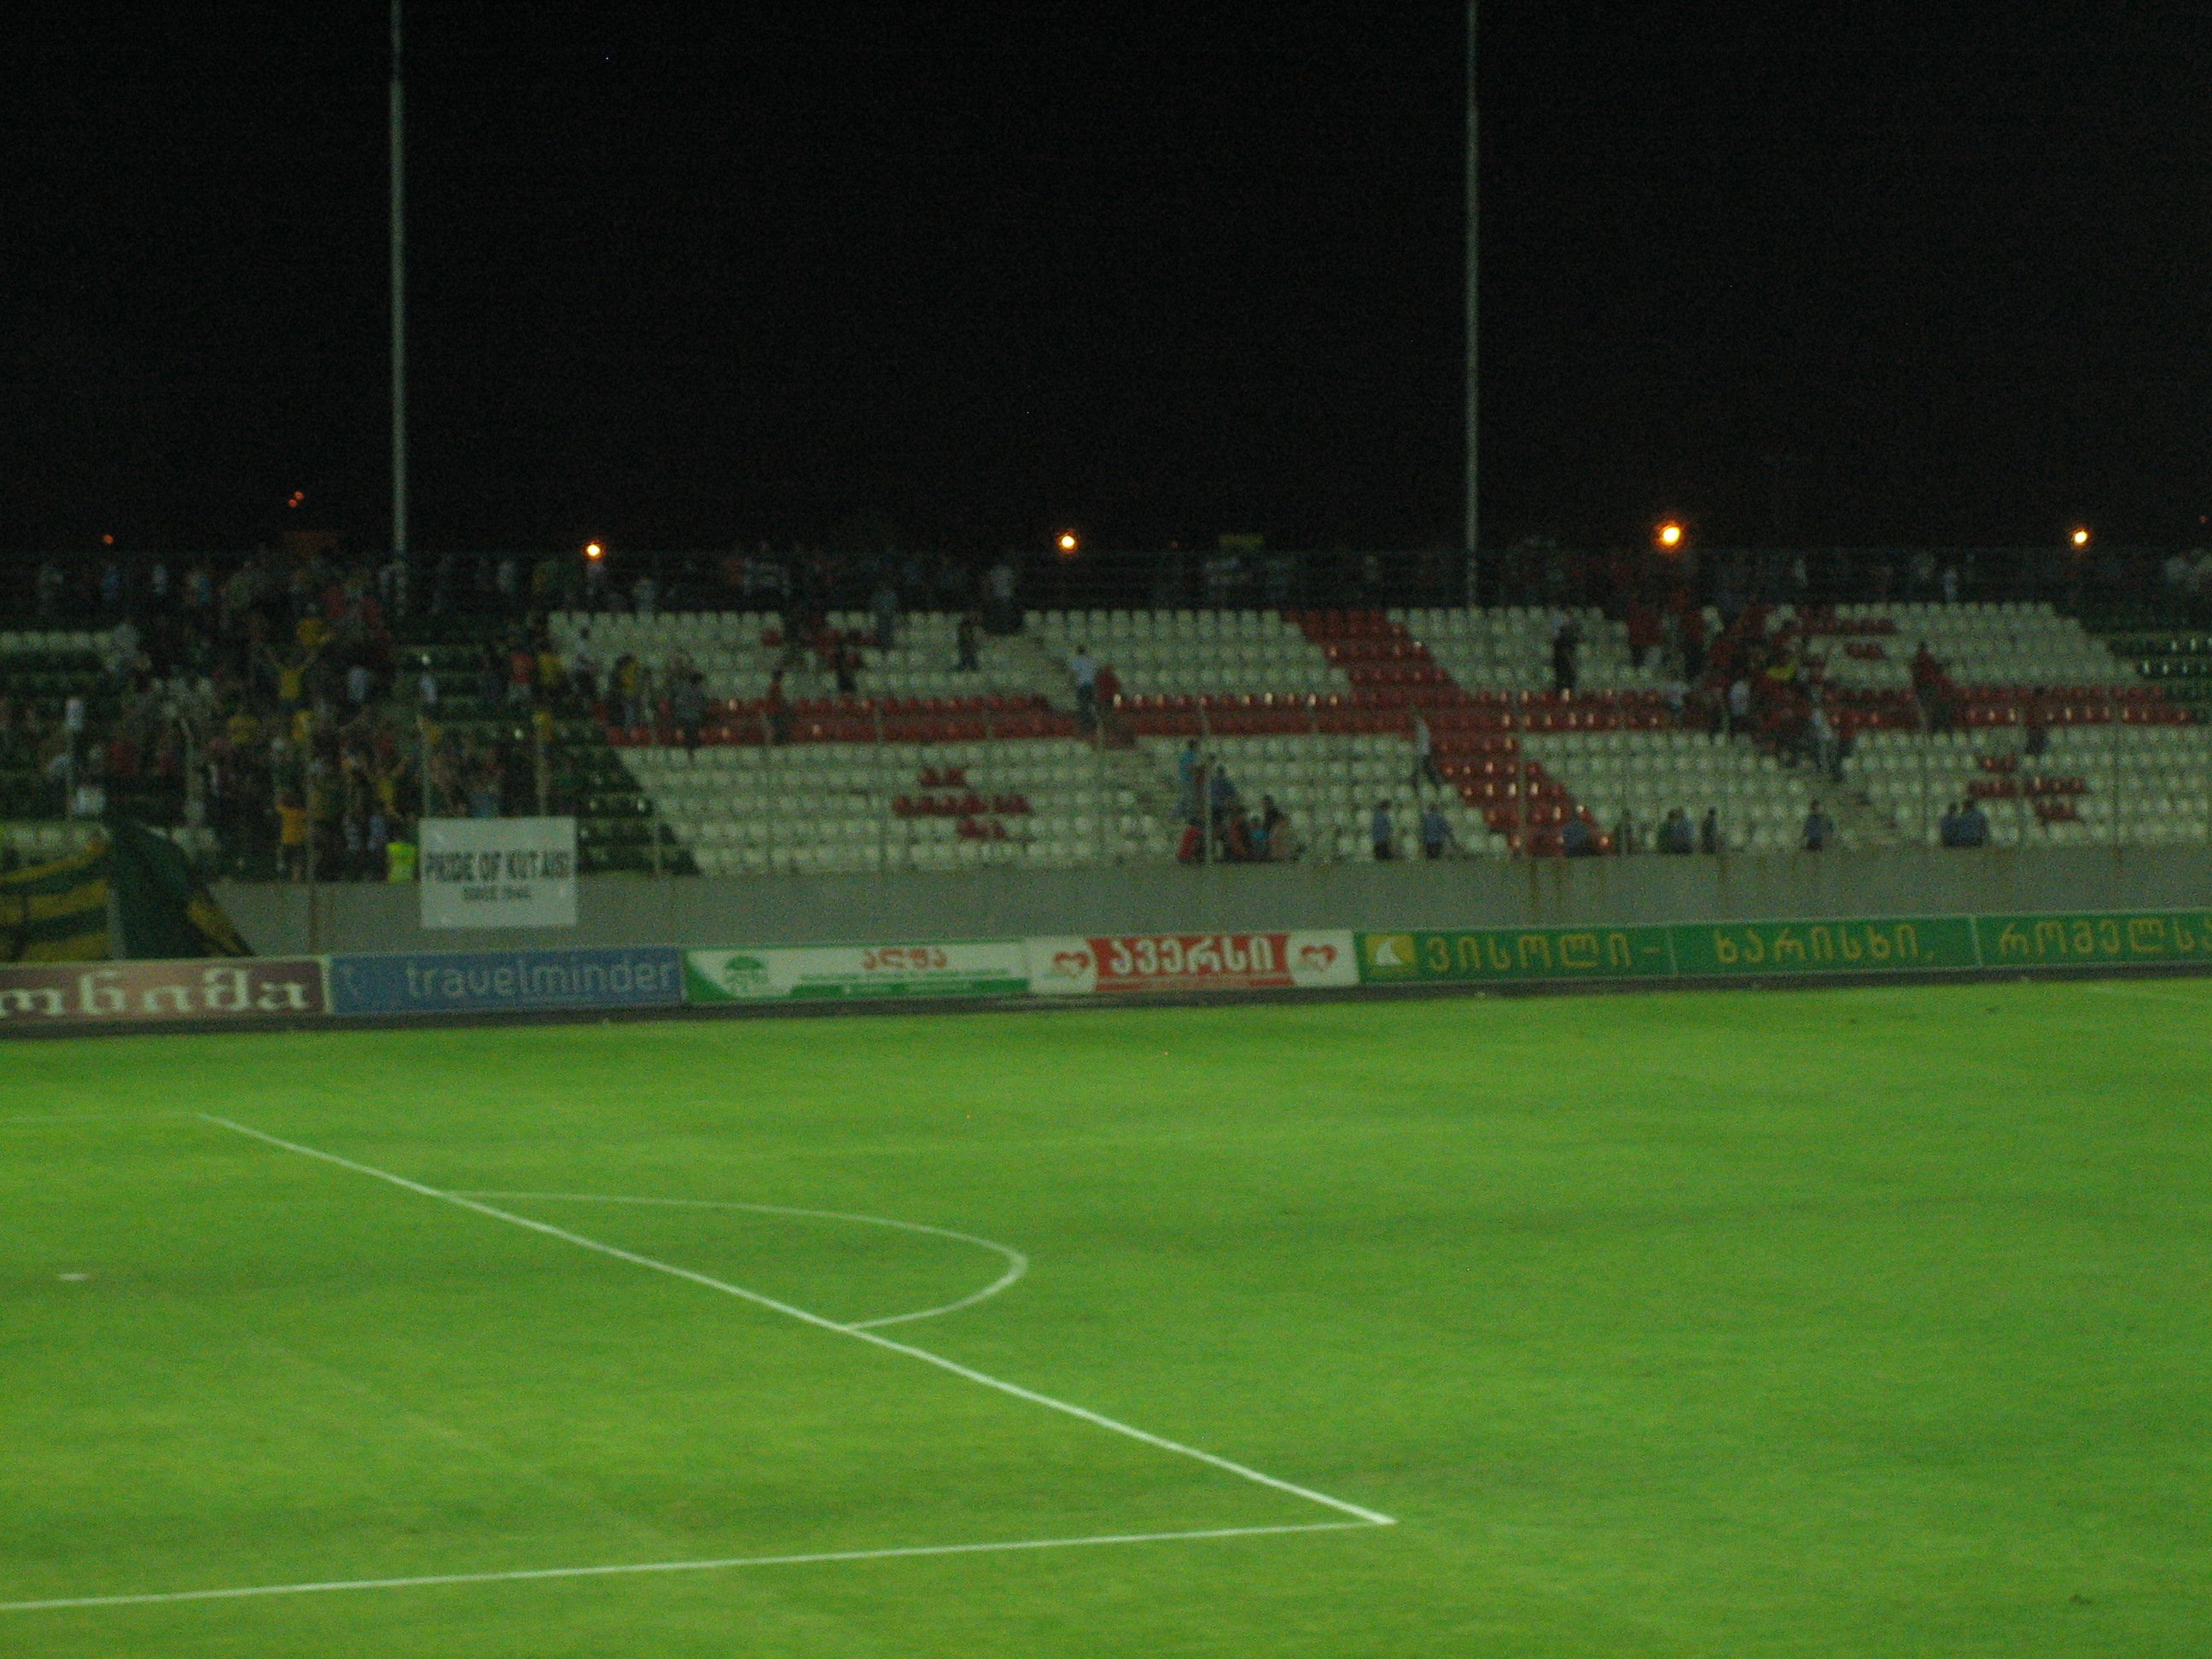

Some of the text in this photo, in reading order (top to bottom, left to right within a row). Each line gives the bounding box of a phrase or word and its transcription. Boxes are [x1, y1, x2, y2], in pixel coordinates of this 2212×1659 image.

[478, 850, 502, 882] OF
[863, 947, 947, 970] ალფა
[1109, 935, 1275, 975] ავერსი
[1426, 932, 1633, 973] ვისოლი
[406, 953, 672, 998] travelminder
